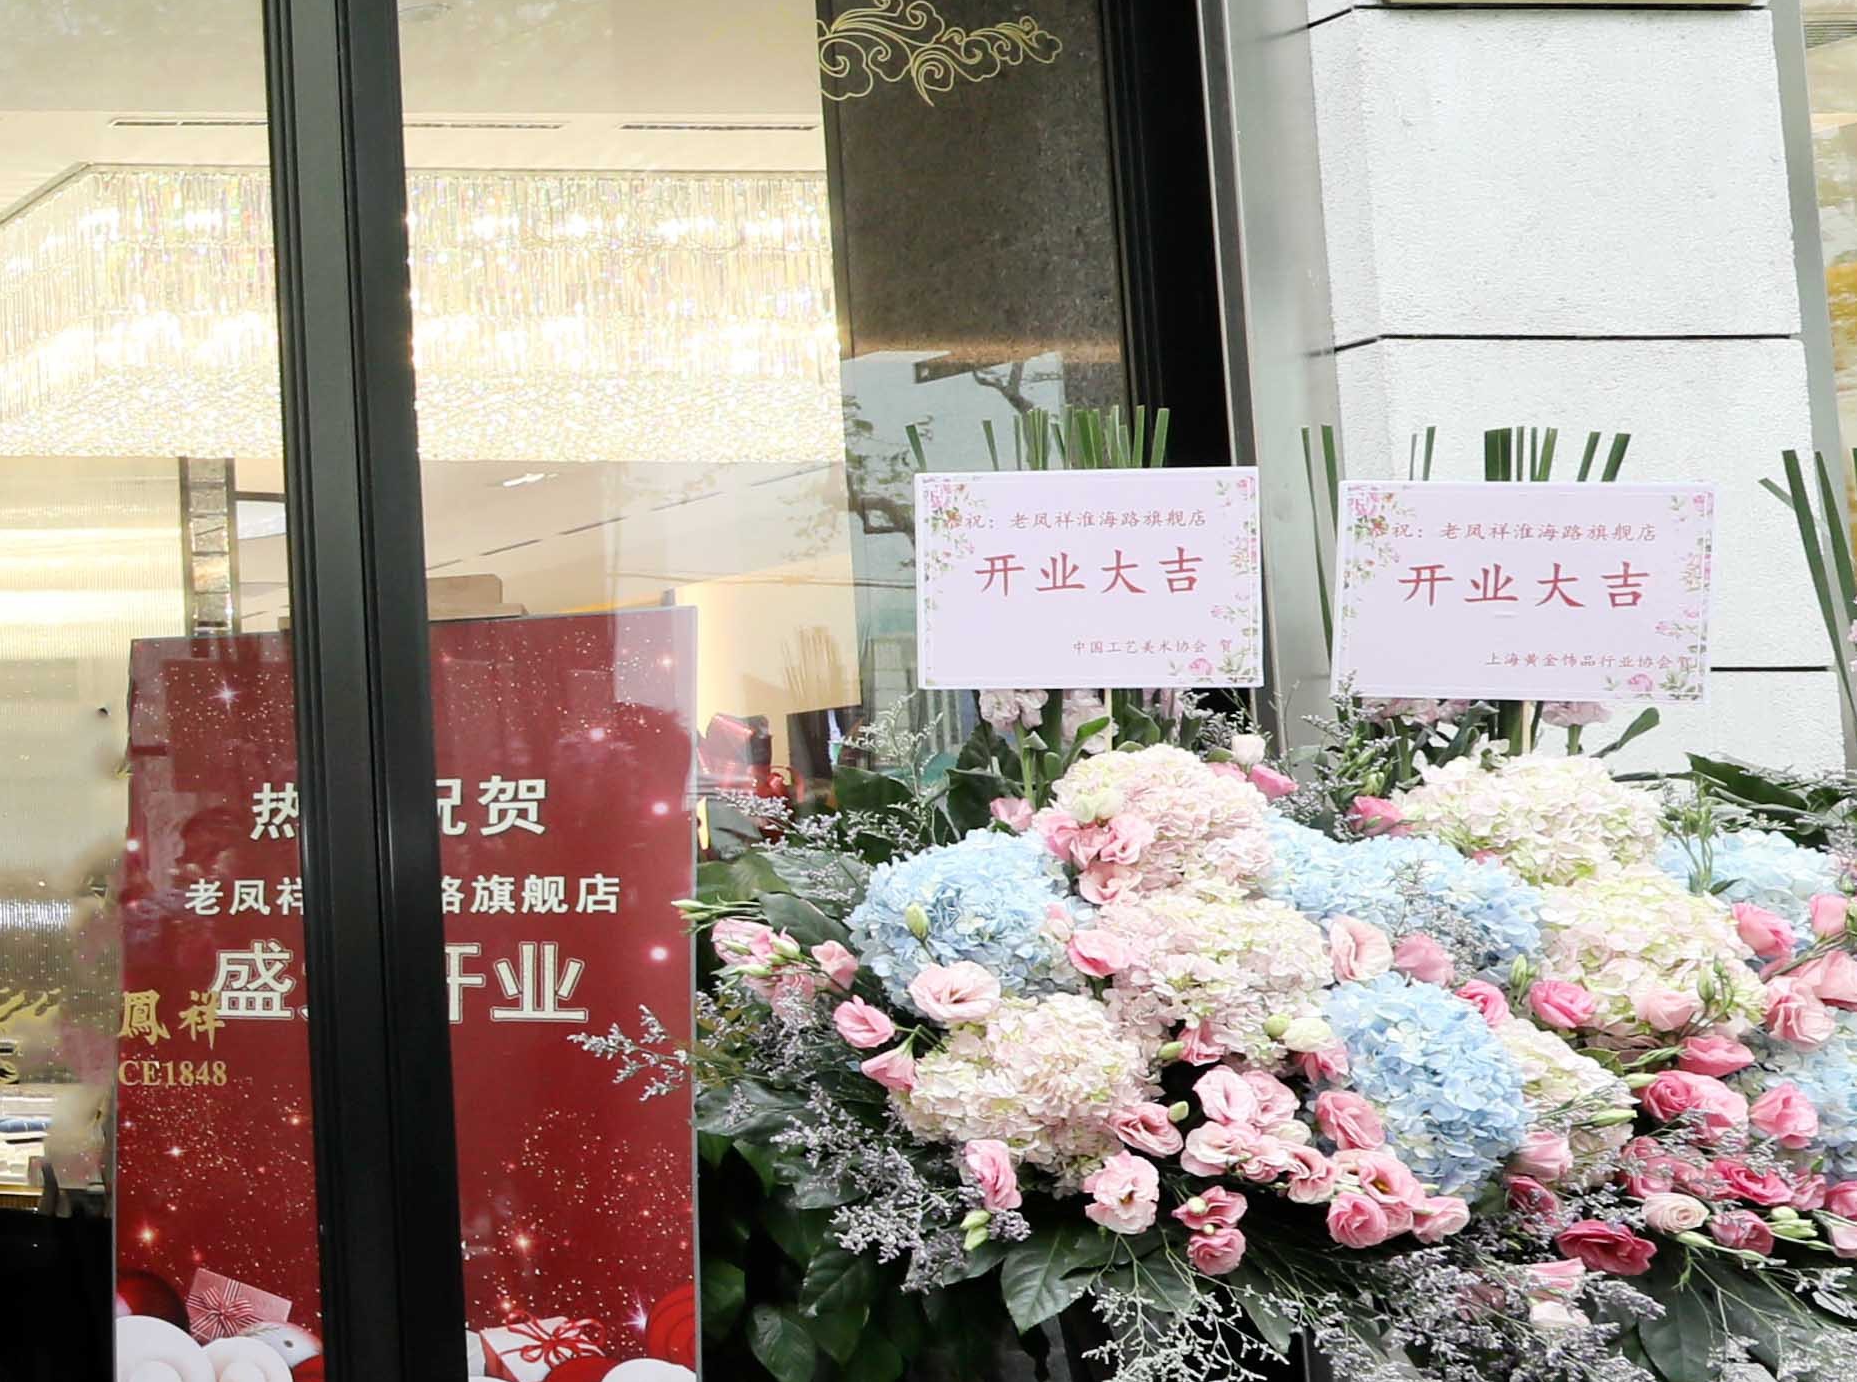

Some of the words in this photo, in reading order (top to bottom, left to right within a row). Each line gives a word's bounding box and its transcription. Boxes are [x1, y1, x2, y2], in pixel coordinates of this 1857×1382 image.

[974, 546, 1204, 597] 开业大吉
[1397, 561, 1651, 608] 开业大吉
